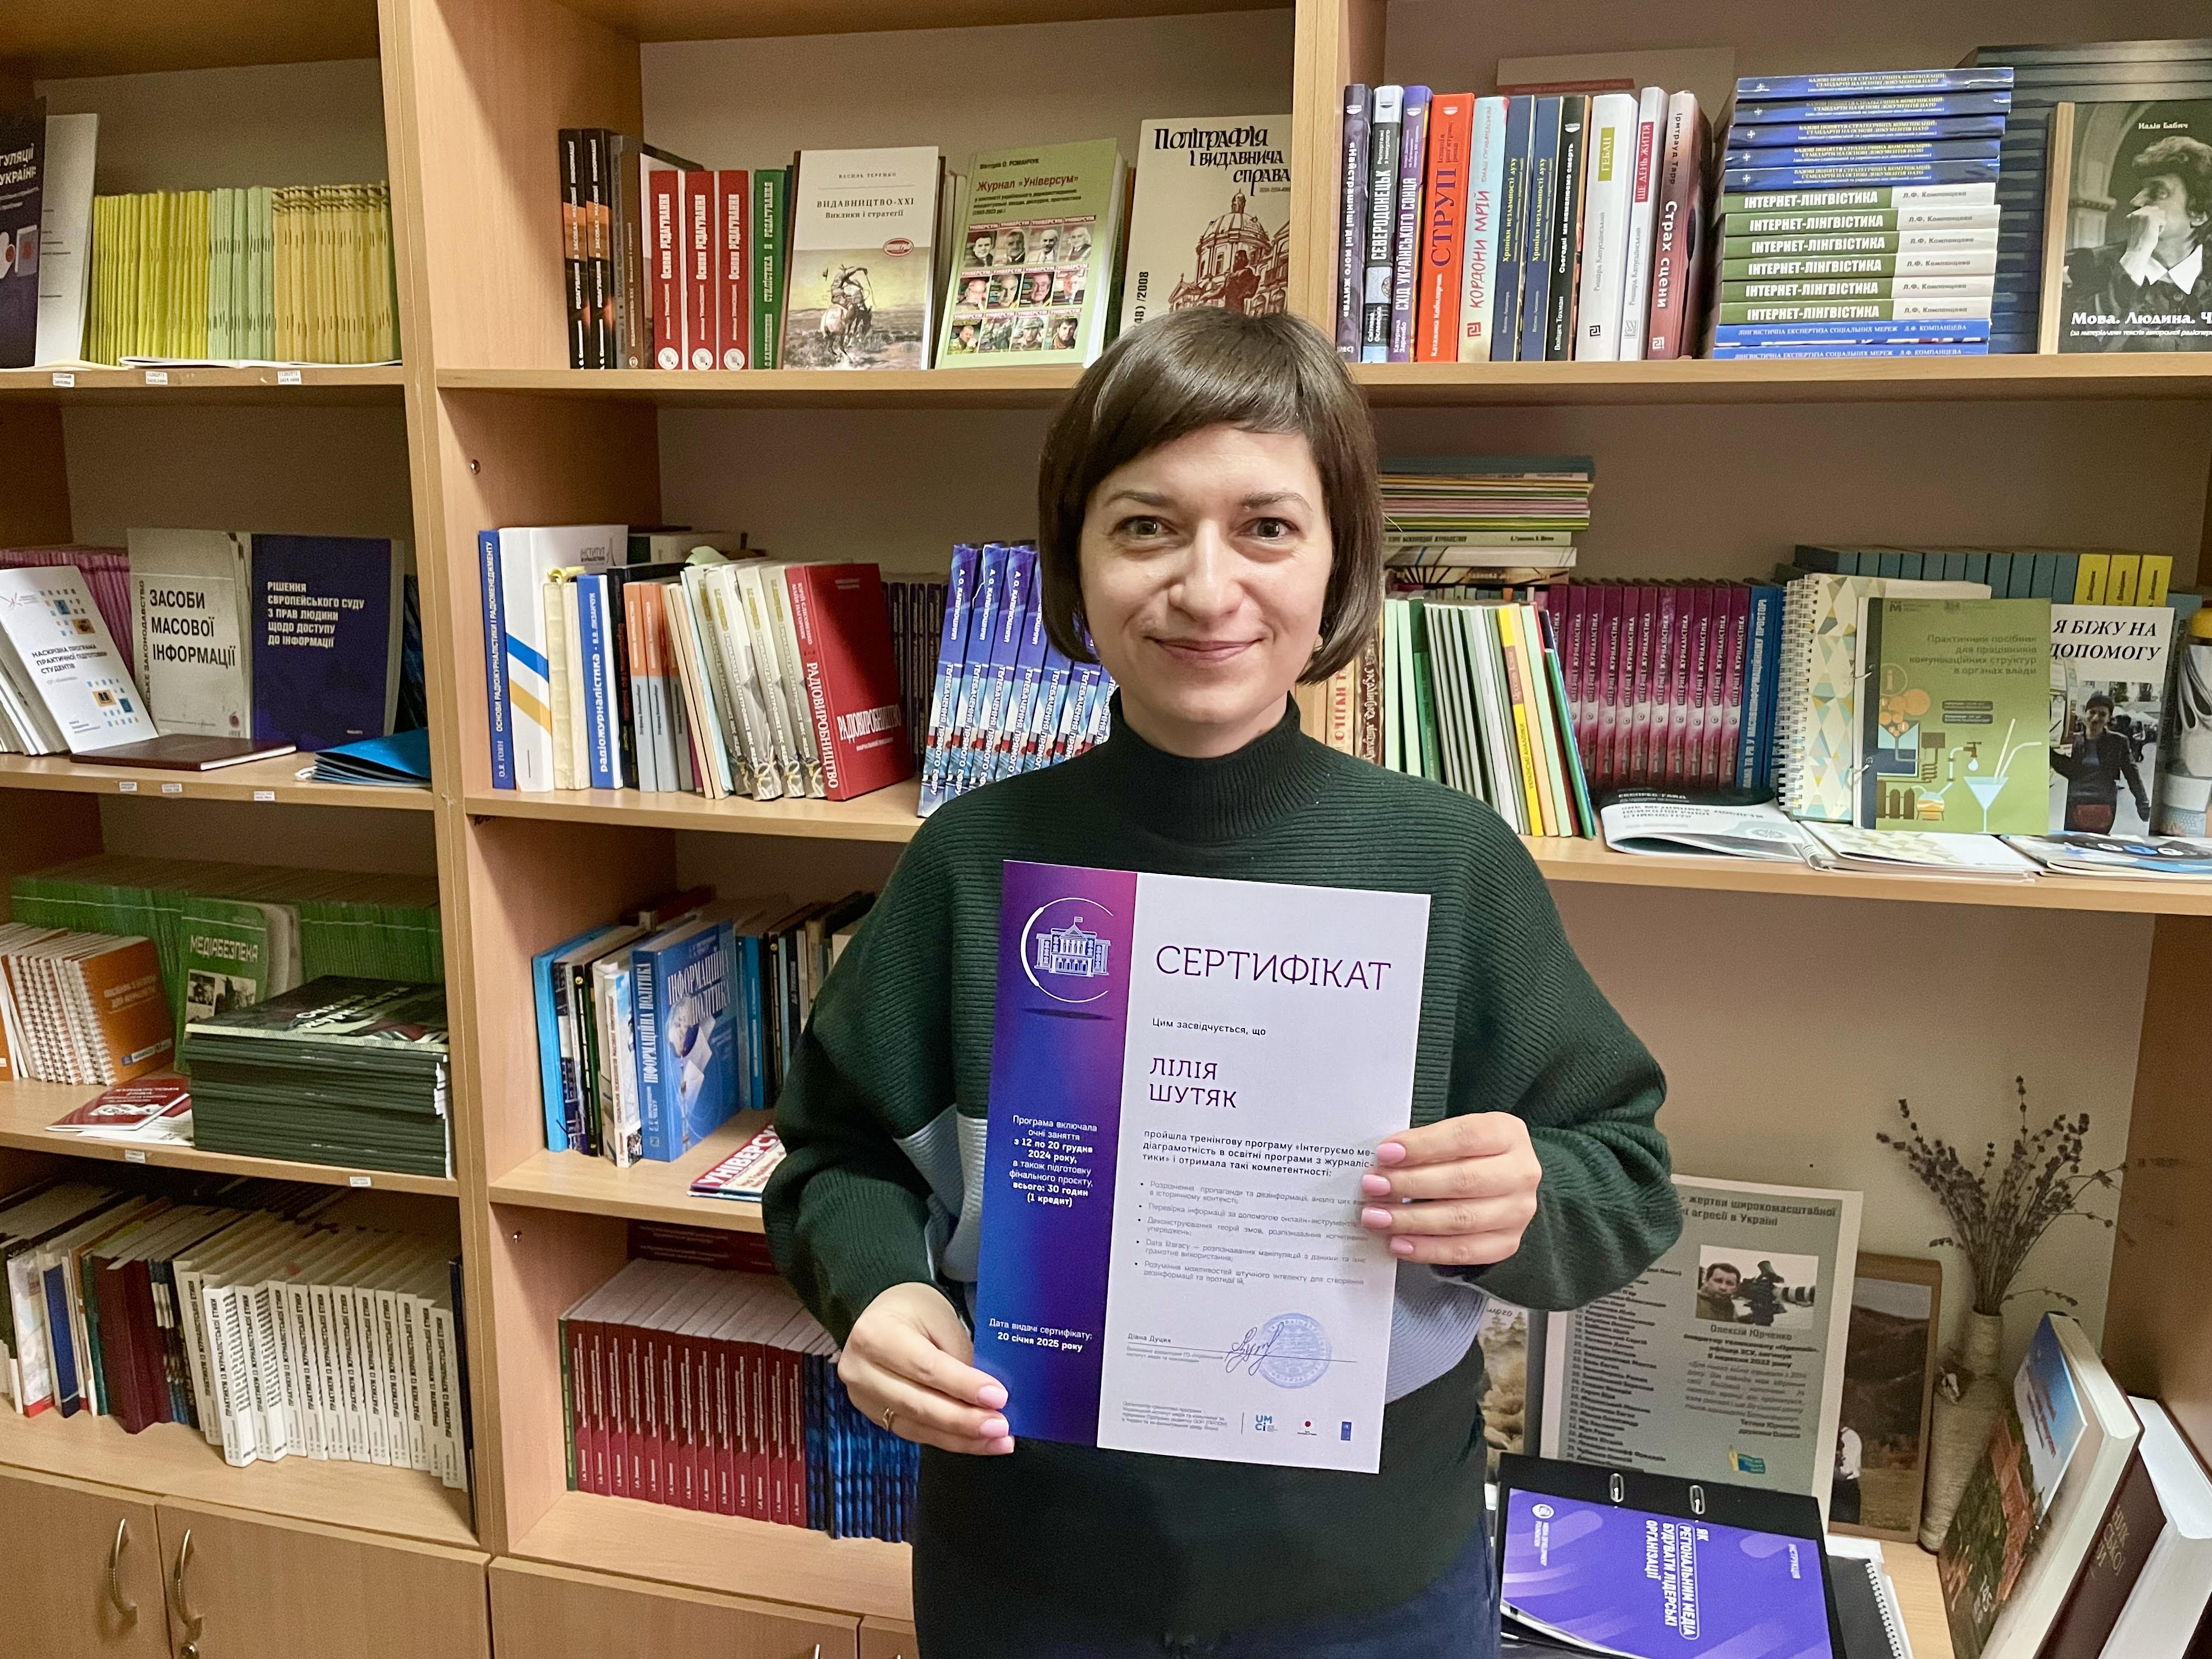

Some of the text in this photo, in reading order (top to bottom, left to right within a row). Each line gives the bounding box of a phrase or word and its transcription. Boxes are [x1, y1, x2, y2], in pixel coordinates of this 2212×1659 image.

[1601, 137, 1611, 171] ГЕБАН
[1638, 125, 1651, 183] ДЕНЬ ЖИТТЯ
[1670, 112, 1683, 184] Ірмтрауд Тарр
[978, 175, 1079, 192] Журнал «Універсум»
[1506, 178, 1515, 227] незламності
[1536, 177, 1544, 227] незламності
[1563, 174, 1572, 222] намалюємо
[1743, 191, 1878, 209] ІНТЕРНЕТ-ЛІНГВІСТИКА
[868, 210, 904, 219] стратегії
[1431, 168, 1457, 267] СТРУП
[1749, 215, 1883, 232] ІНТЕРНЕТ-ЛІНГВІСТИКА
[1345, 229, 1354, 247] дні
[1396, 178, 1417, 311] СХІД УКРАЇНСЬКОГО СОНЦЯ
[1751, 237, 1885, 253] ІНТЕРНЕТ-ЛІНГВІСТИКА
[1469, 190, 1491, 308] КОРДОНИ МРІЙ
[1559, 238, 1568, 273] Сьогодні
[1657, 200, 1678, 308] Страх сцени
[1748, 259, 1882, 276] ІНТЕРНЕТ-ЛІНГВІСТИКА
[1746, 282, 1878, 297] ІНТЕРНЕТ-ЛІНГВІСТИКА
[1747, 306, 1879, 321] ІНТЕРНЕТ-ЛІНГВІСТИКА
[2070, 311, 2196, 325] Мова. Людина.
[267, 582, 307, 593] РІШЕННЯ
[149, 589, 205, 610] ЗАСОБИ
[268, 595, 365, 610] ЄВРОПЕЙСЬКОГО СУДУ
[275, 609, 338, 622] ПРАВ ЛЮДИНИ
[1756, 599, 1767, 636] ПРОСТОРІ
[151, 616, 215, 637] МАСОВОЇ
[268, 622, 335, 635] ЩОДО ДОСТУПУ
[2052, 620, 2157, 636] Я БІЖУ НА
[268, 635, 334, 648] ДО ІНФОРМАЦІЇ
[1927, 634, 1988, 645] Практичний
[153, 644, 236, 669] ІНФОРМАЦІЇ
[1955, 646, 1974, 655] для
[2050, 644, 2162, 661] ДОПОМОГУ
[2006, 666, 2036, 675] влади
[1015, 667, 1034, 729] ТЕЛЕБАЧЕННЯ
[592, 653, 608, 773] радіожурналістика
[837, 703, 902, 744] РАДІОВИРОБНИЦТВО
[933, 663, 953, 772] ТЕЛЕБАЧЕННЯ ПРЯМОГО
[958, 664, 982, 774] ТЕЛЕБАЧЕННЯ ПРЯМОГО
[981, 665, 1006, 773] ТЕЛЕБАЧЕННЯ ПРЯМОГО
[806, 661, 839, 789] РАДІОВИРОБНИЦТВО
[190, 934, 258, 963] МЕДІАБЕЗПЕКА
[1156, 945, 1392, 991] СЕРТИФІКАТ
[636, 963, 654, 1010] ПОЛІТИКА
[1152, 1017, 1266, 1036] Цим засвідчується, що
[1149, 1057, 1218, 1080] ЛІЛІЯ
[1149, 1083, 1237, 1109] ШУТЯК
[1013, 1115, 1097, 1132] Програма включала
[1022, 1138, 1032, 1147] 12
[1048, 1141, 1059, 1149] 20
[1062, 1144, 1093, 1153] грудня
[1048, 1131, 1080, 1141] заняття
[1144, 1130, 1187, 1141] пройшла
[1190, 1135, 1242, 1147] тренінгову
[1245, 1139, 1293, 1152] програму
[1296, 1143, 1354, 1155] «Інтегруємо
[697, 1124, 780, 1185] УНІВЕРСУ
[1028, 1149, 1077, 1164] 2024 року,
[1143, 1142, 1216, 1155] діаграмотність
[1228, 1150, 1261, 1159] освітні
[1265, 1153, 1312, 1164] програми
[1325, 1159, 1374, 1168] журналіс-
[1047, 1164, 1091, 1177] підготовку
[1143, 1154, 1170, 1162] тики»
[1179, 1157, 1226, 1168] отримала
[1231, 1161, 1248, 1170] такі
[1252, 1164, 1331, 1177] компетентності:
[1009, 1170, 1093, 1188] фінального проєкту,
[1013, 1182, 1088, 1197] всього: 30 годин
[1027, 1192, 1073, 1207] (1 кредит)
[1689, 1195, 1836, 1217] жертви широкомасштабної
[1149, 1203, 1185, 1214] Перевірка
[1238, 1212, 1278, 1221] допомогою
[1691, 1209, 1728, 1222] агресії
[1740, 1212, 1778, 1227] Україні
[1146, 1238, 1163, 1246] Data
[989, 1318, 1092, 1341] Дата видачі сертифікату:
[1127, 1333, 1147, 1341] Діана
[1710, 1324, 1747, 1336] Олексій
[997, 1331, 1083, 1353] 20 січня 2025 року
[1255, 1414, 1273, 1424] UM
[1695, 1527, 1709, 1542] ЯК
[1644, 1520, 1661, 1580] ОРГАНІЗАЦІЇ
[1661, 1522, 1678, 1627] БУДУВАТИ ЛІДЕРСЬКІ
[1679, 1525, 1696, 1635] РЕГІОНАЛЬНИМ МЕДІА
